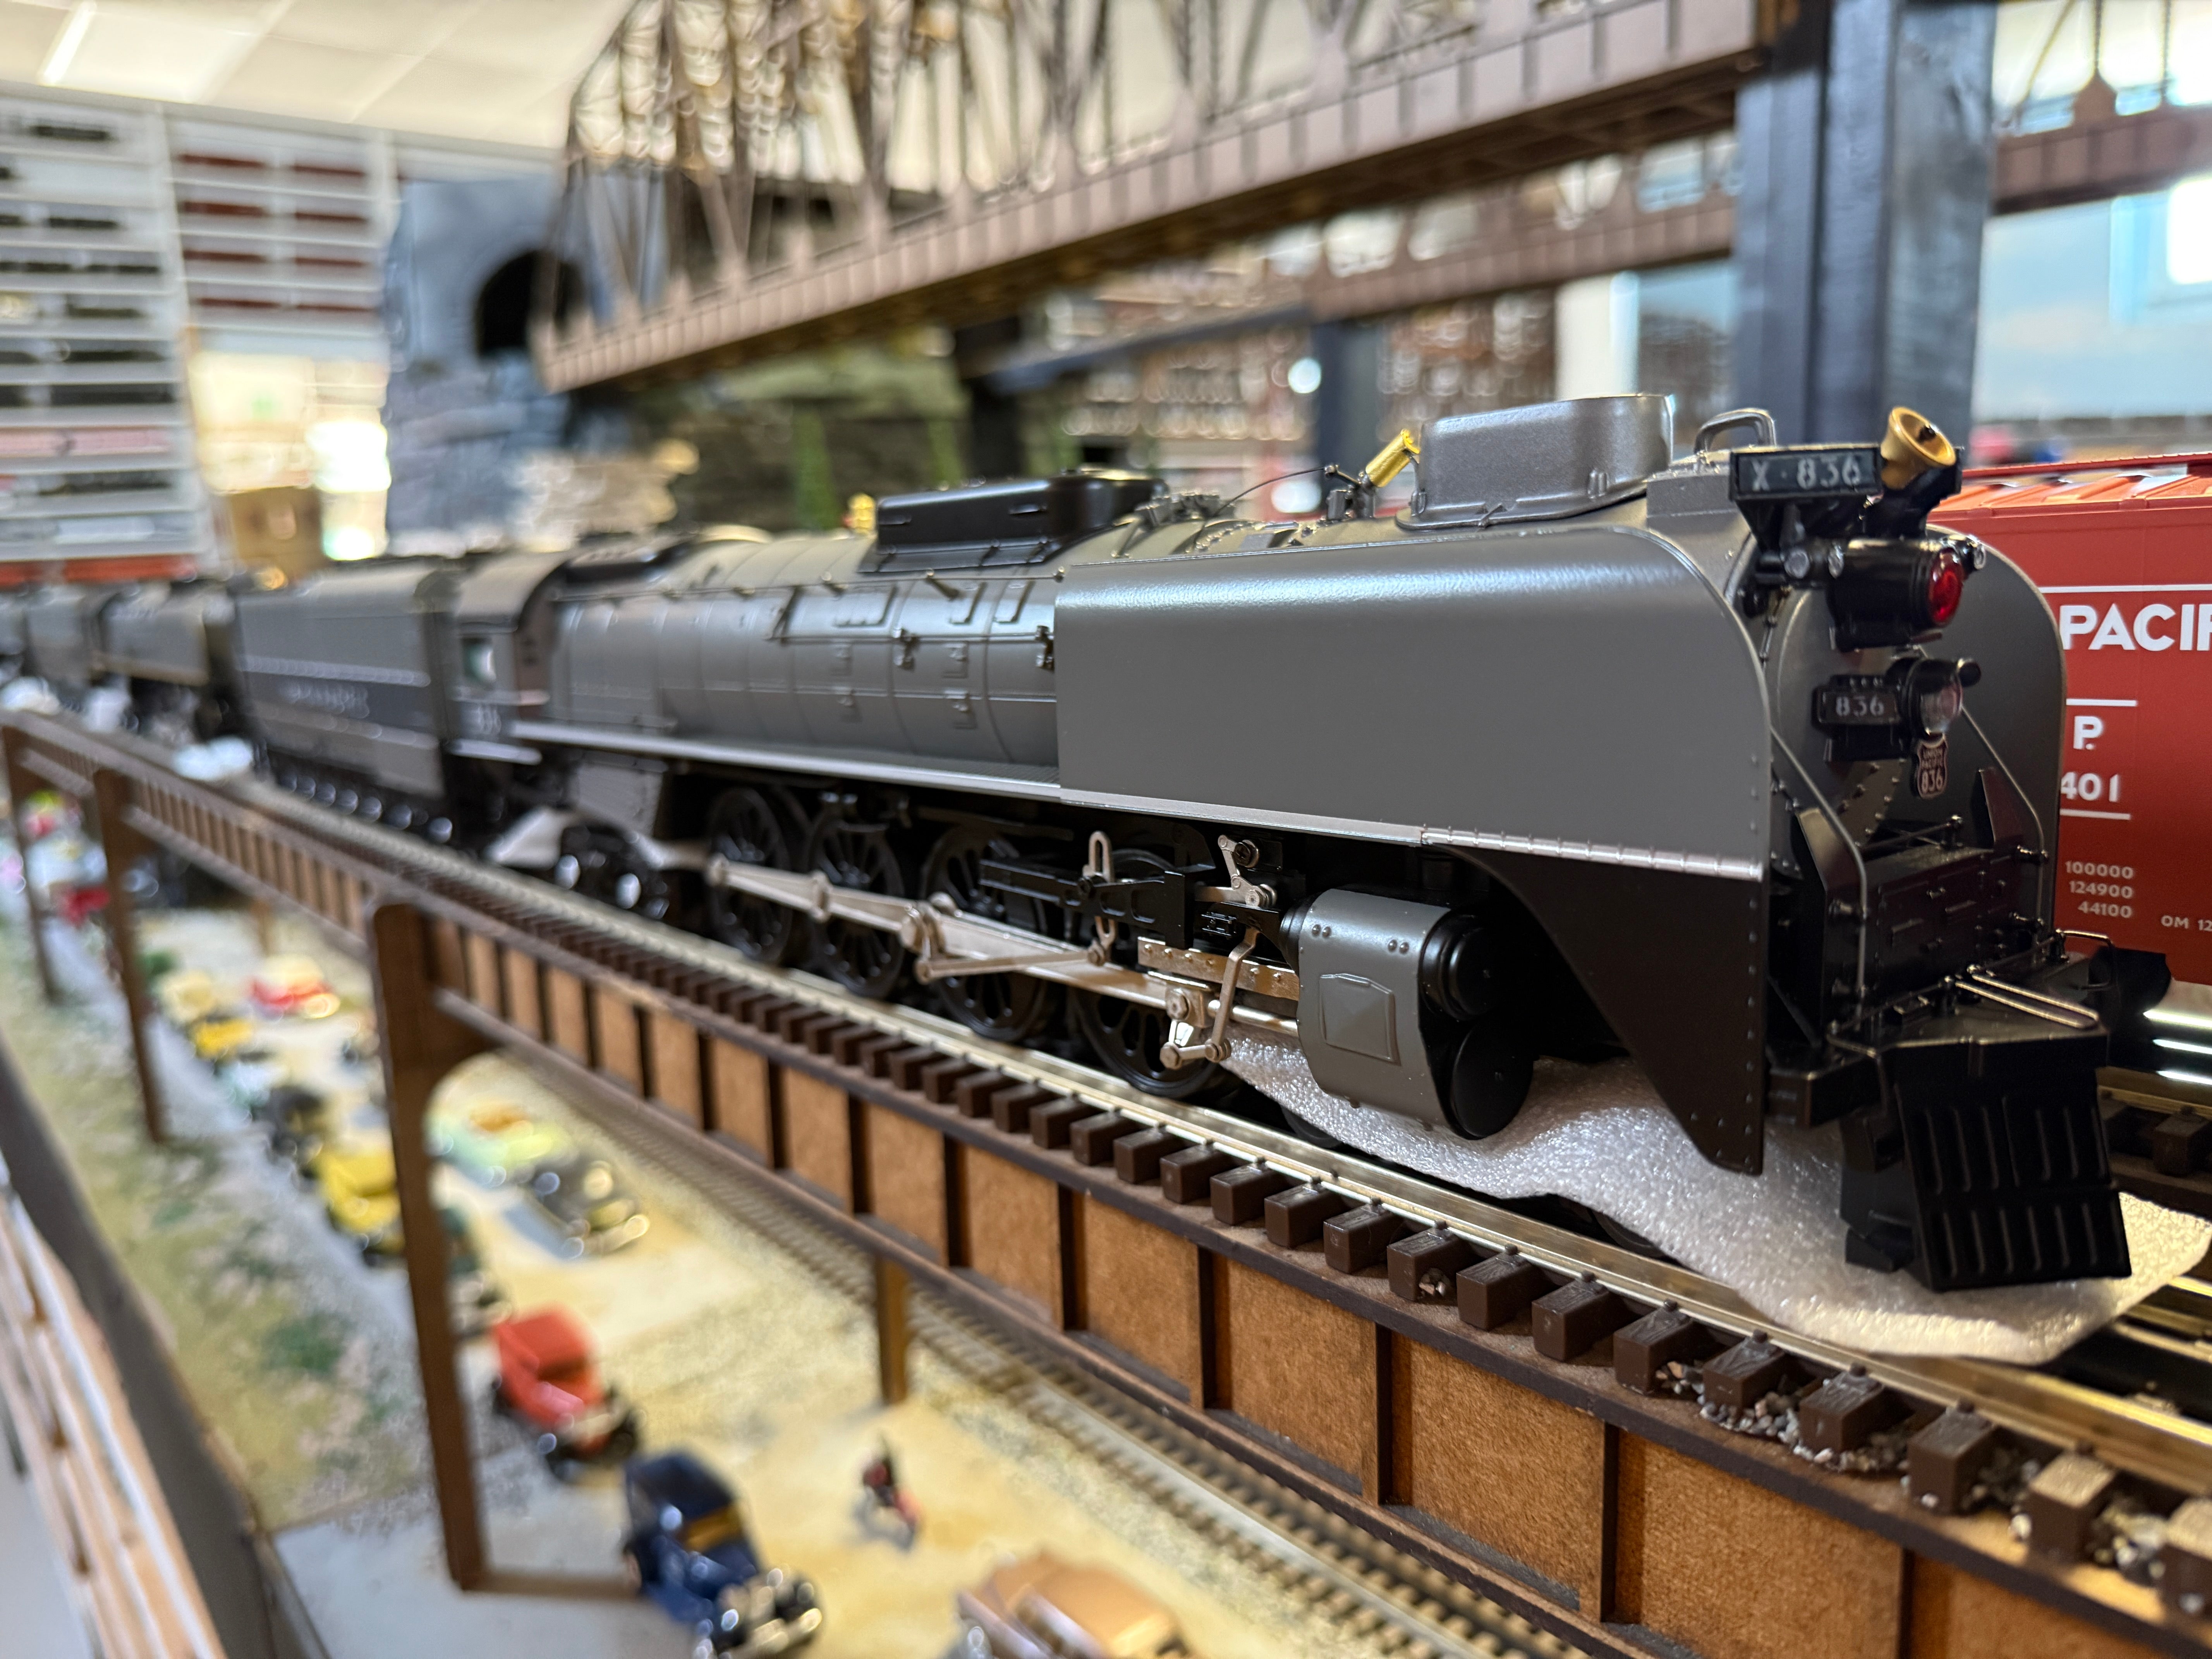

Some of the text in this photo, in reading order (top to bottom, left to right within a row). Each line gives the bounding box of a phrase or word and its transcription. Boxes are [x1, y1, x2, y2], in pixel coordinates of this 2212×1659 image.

[1751, 453, 1861, 491] X 836
[1836, 695, 1885, 717] 836
[2061, 771, 2123, 803] 401
[2065, 860, 2134, 879] 100000
[2069, 880, 2134, 899] 124900
[2078, 901, 2133, 918] 44100
[2161, 915, 2212, 932] OM 12
